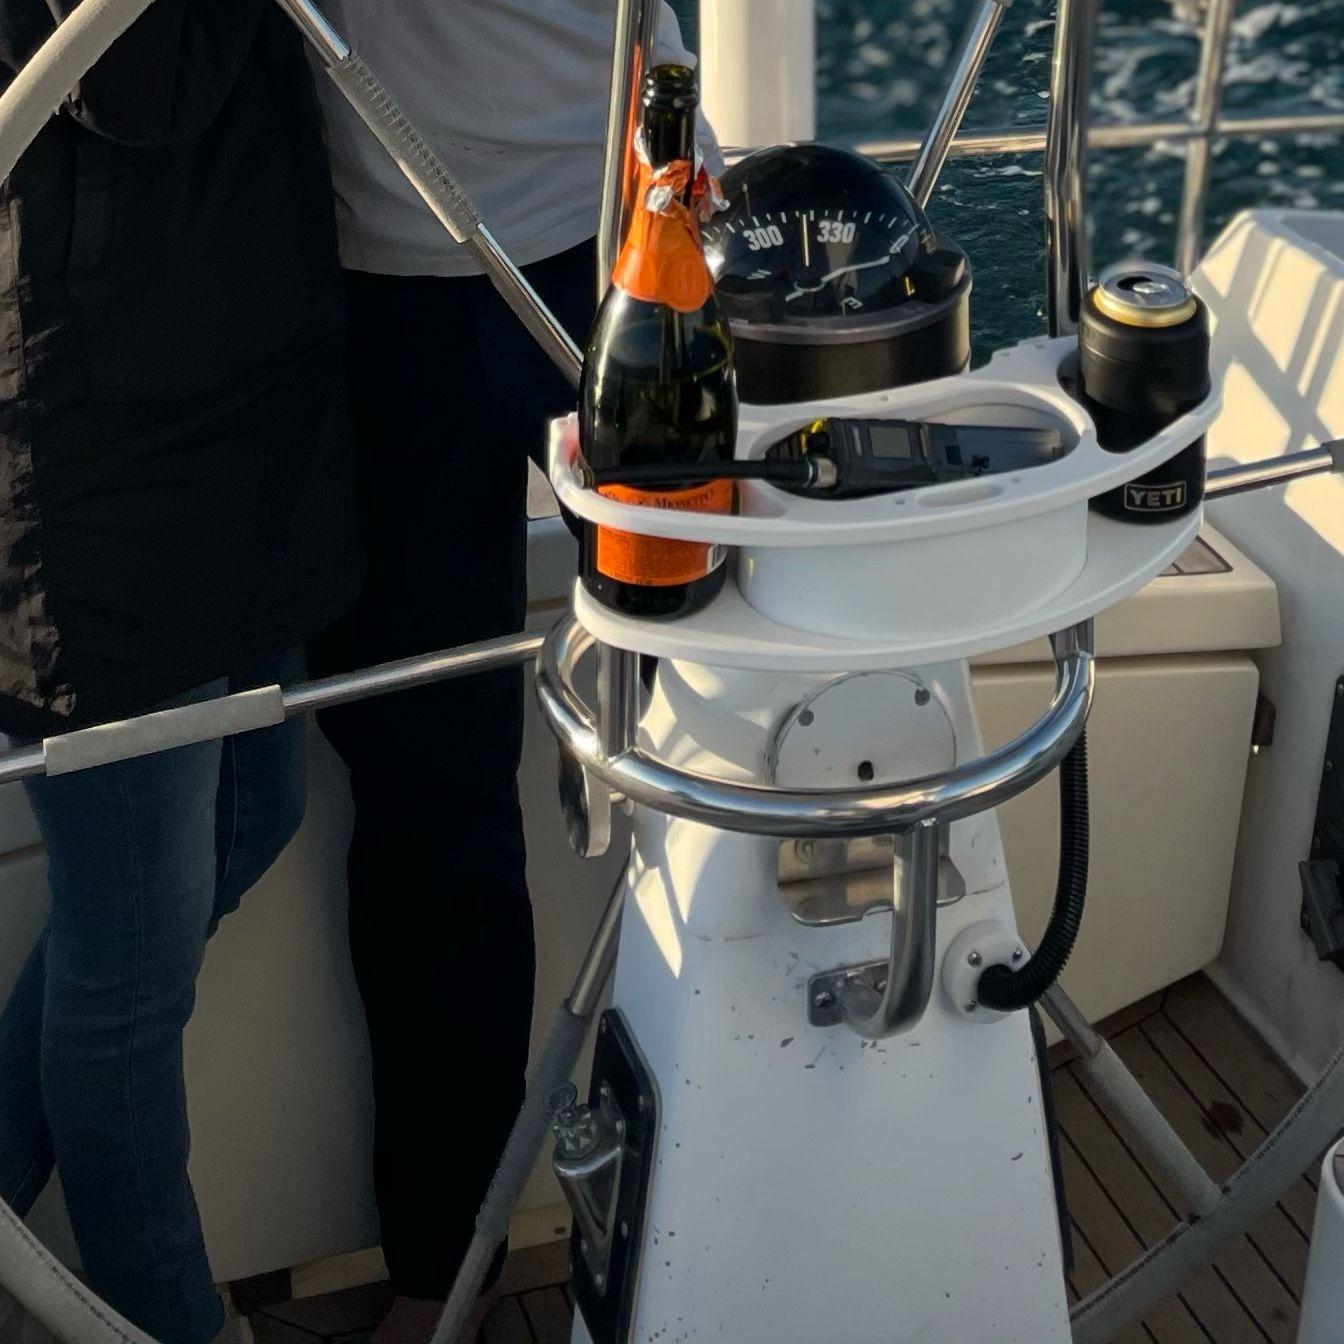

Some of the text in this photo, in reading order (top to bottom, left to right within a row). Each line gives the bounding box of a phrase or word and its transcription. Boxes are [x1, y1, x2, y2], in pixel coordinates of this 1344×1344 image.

[742, 220, 857, 251] 300 330
[1128, 486, 1183, 508] YETI
